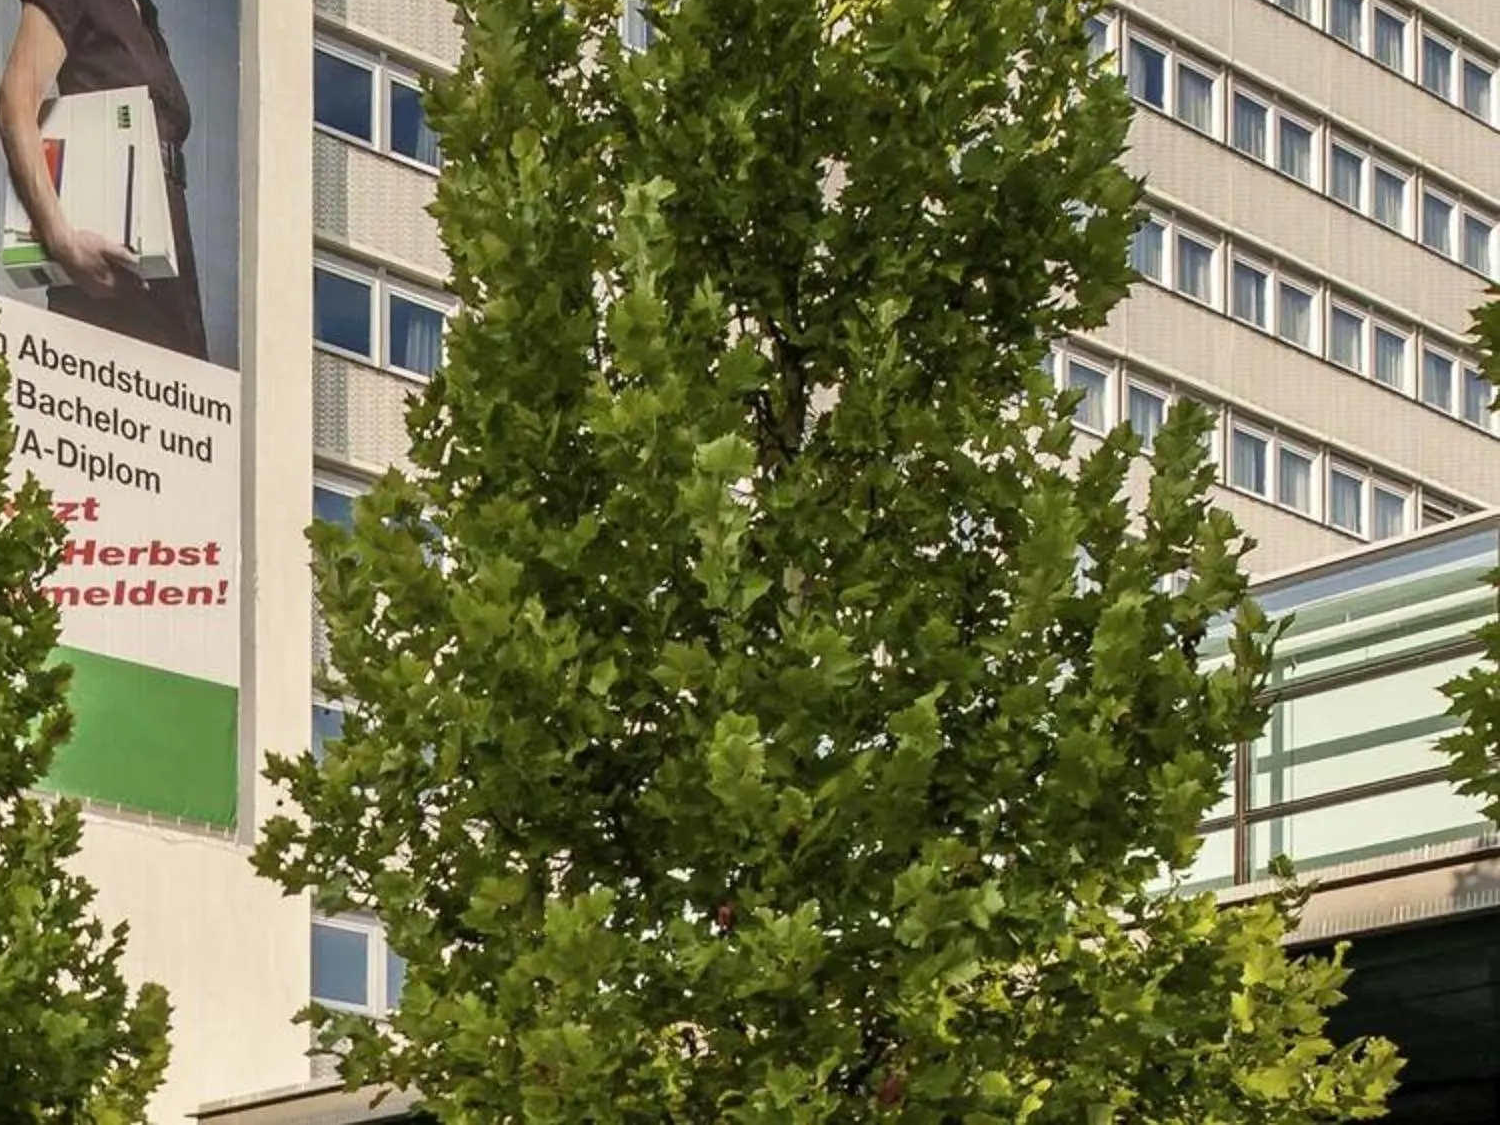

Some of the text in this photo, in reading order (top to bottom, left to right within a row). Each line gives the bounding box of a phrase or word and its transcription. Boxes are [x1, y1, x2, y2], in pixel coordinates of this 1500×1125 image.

[18, 333, 232, 424] Abendstudium
[17, 378, 213, 463] Bachelor und
[12, 425, 161, 493] A-Diplom
[60, 540, 221, 566] Herbst
[41, 580, 229, 606] melden!
